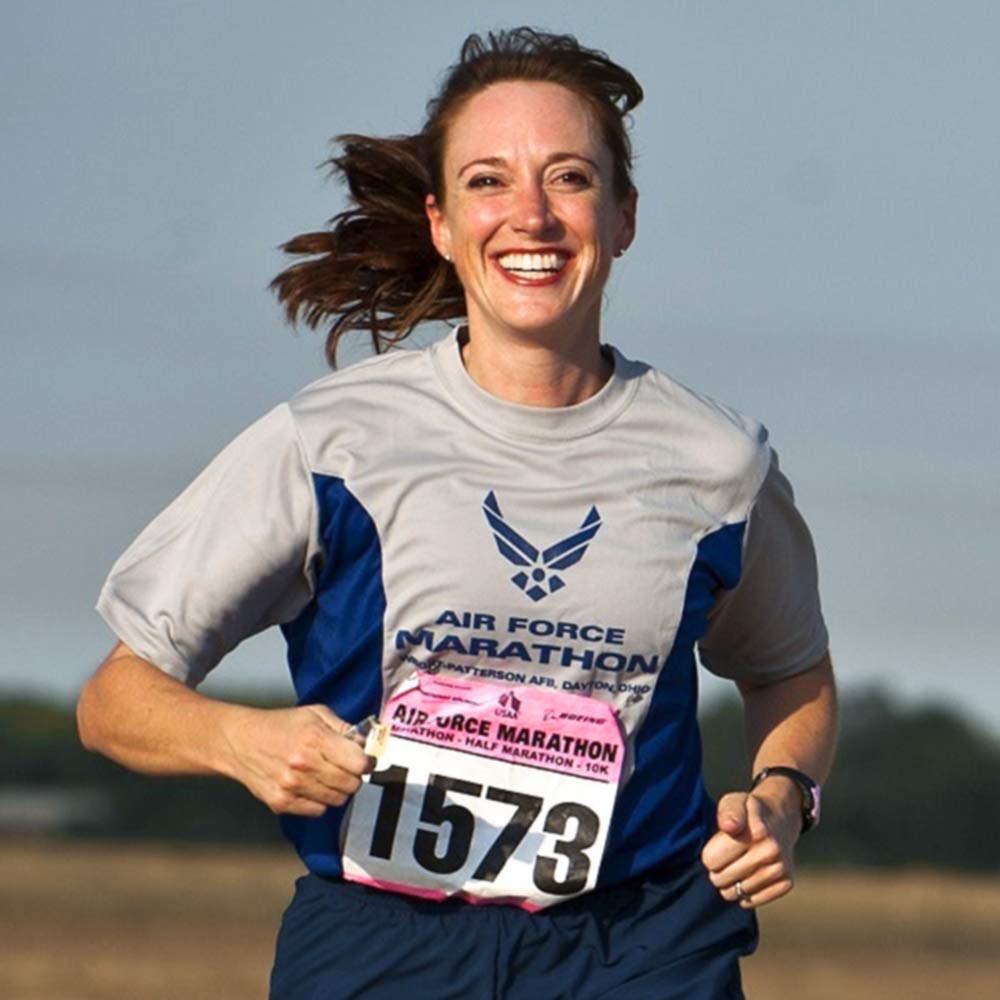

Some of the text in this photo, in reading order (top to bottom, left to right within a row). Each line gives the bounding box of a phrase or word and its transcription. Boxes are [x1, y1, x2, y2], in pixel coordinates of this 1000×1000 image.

[435, 610, 625, 645] AIR FORCE
[395, 629, 659, 674] MARATHON
[392, 703, 619, 763] AIR ORCE MARATHON
[465, 737, 498, 751] HALF
[502, 744, 574, 768] MARATHON
[586, 762, 609, 775] 10K
[369, 763, 601, 896] 1573
